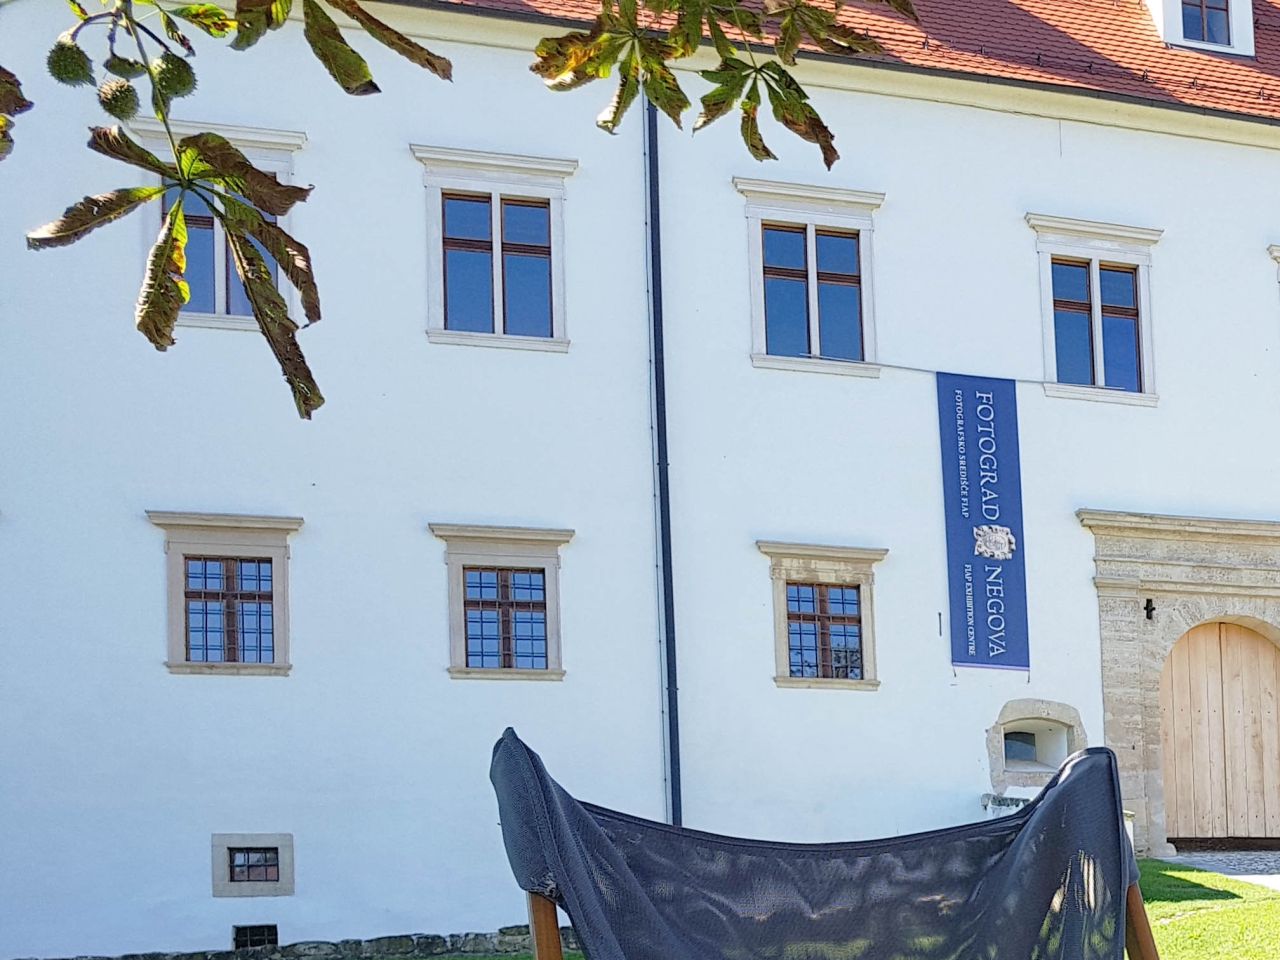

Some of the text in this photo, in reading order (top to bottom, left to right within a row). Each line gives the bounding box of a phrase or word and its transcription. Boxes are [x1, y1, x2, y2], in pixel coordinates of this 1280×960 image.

[954, 389, 970, 519] FOTOGRAFSKO SREDIŠČE FIAP
[976, 390, 1006, 658] FOTOGRAD NEGOVA
[964, 564, 976, 656] FIAP EXHIBITION CENTRE
